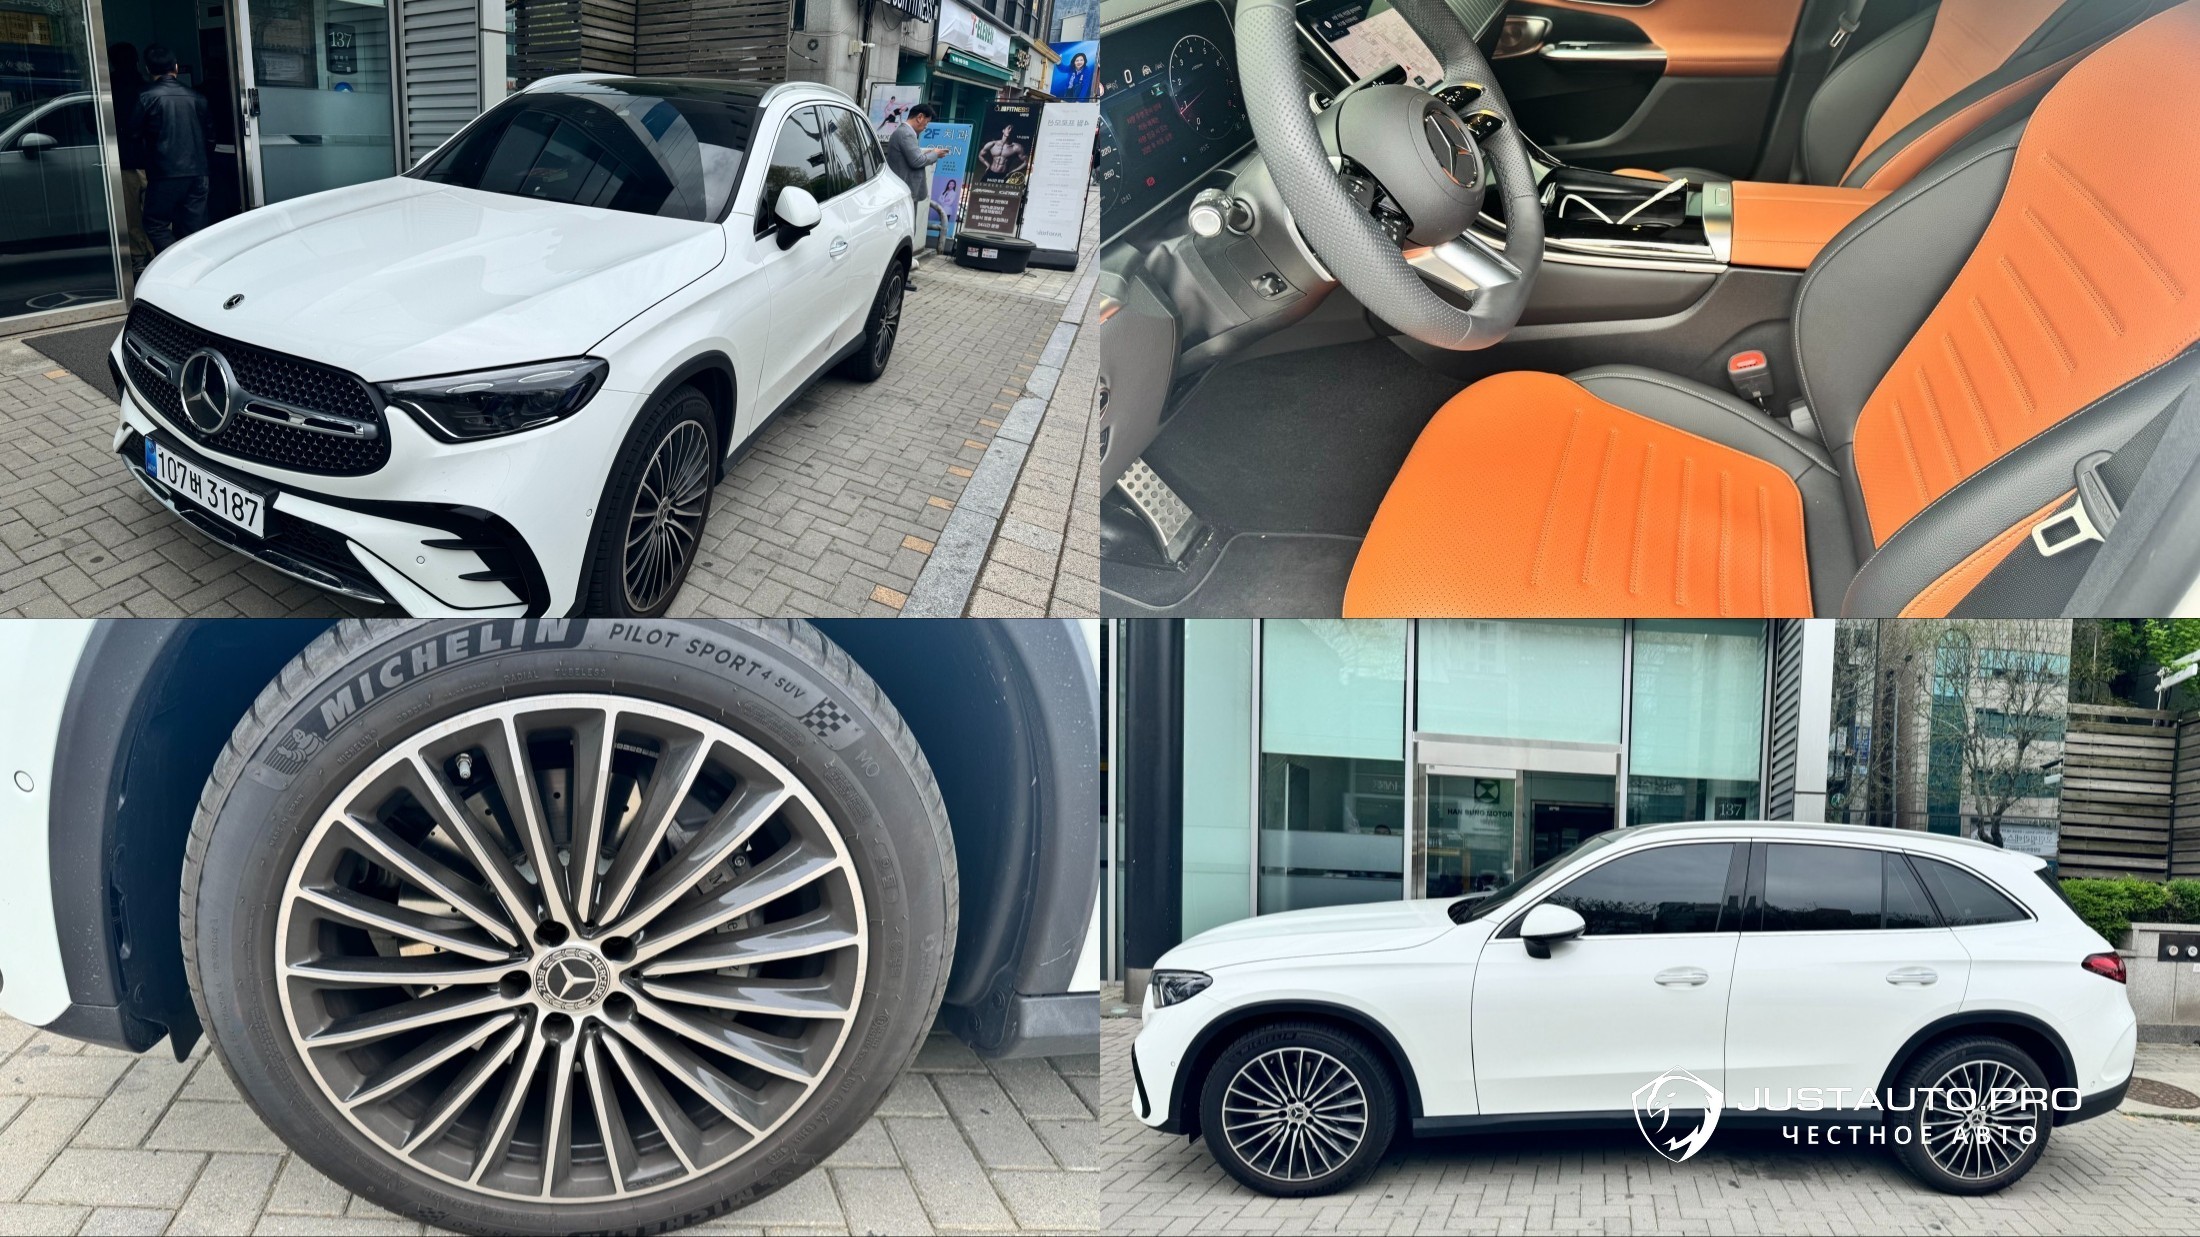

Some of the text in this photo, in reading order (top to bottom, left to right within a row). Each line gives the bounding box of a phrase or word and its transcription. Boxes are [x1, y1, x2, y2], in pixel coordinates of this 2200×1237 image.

[329, 32, 352, 48] 137
[1124, 69, 1133, 84] 0
[924, 128, 941, 139] 2F
[158, 451, 258, 527] 107버 3187
[609, 624, 807, 699] PILOT SPORT 4 SUV
[320, 619, 571, 731] MICHELIN
[502, 669, 539, 683] RADIAL
[1447, 808, 1463, 816] HAN
[1486, 810, 1513, 818] MOTOR
[1719, 803, 1742, 816] 137
[536, 969, 547, 993] BENZ
[591, 958, 607, 1001] MERCEDES
